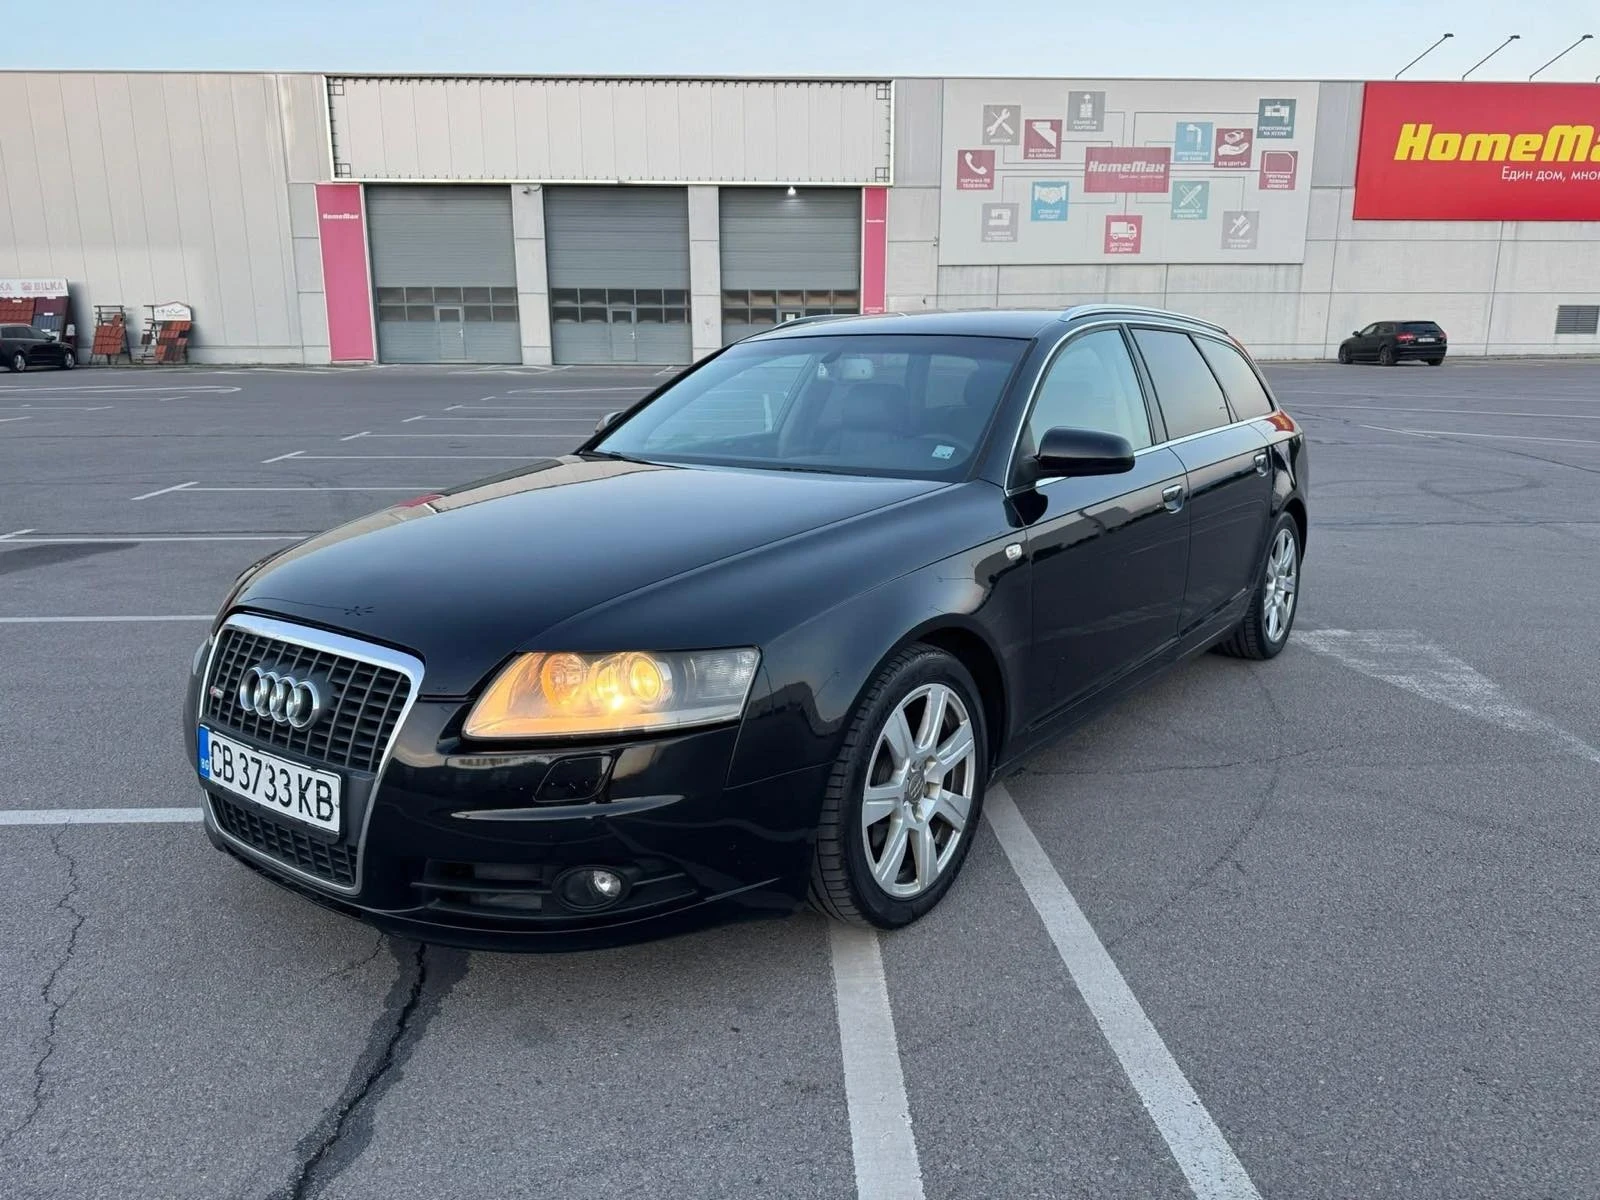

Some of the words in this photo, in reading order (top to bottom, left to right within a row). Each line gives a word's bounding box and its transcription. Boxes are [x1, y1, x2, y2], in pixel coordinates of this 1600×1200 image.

[1088, 160, 1165, 173] HomeMax
[1501, 166, 1533, 182] Един
[1536, 170, 1566, 183] дом,
[1571, 171, 1600, 180] мно
[211, 740, 234, 783] CB
[238, 752, 293, 807] 3733
[298, 773, 334, 822] KB
